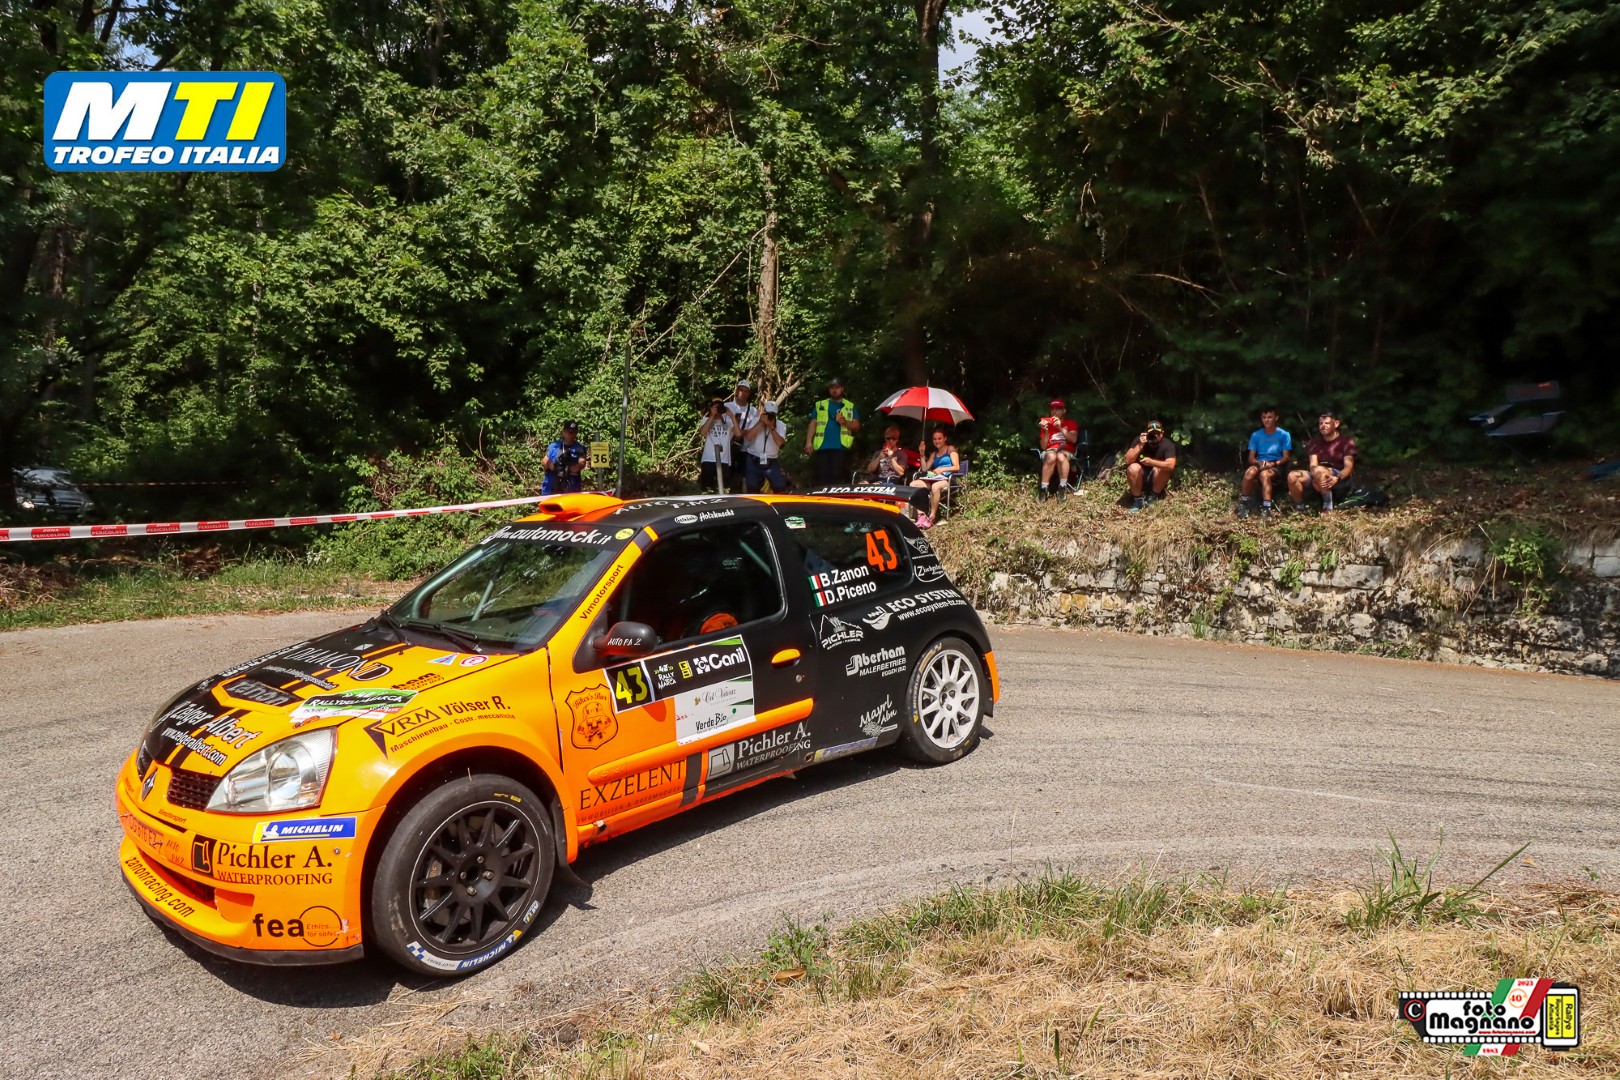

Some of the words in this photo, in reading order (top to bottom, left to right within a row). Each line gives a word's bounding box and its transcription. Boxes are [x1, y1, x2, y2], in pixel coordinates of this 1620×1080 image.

[593, 454, 608, 464] 36
[853, 486, 896, 495] SYSTEM
[865, 529, 898, 572] 43
[579, 564, 625, 620] Vimotorsport
[886, 596, 917, 613] ECO
[914, 588, 961, 604] SYSTEM
[821, 630, 864, 649] PICHLER
[708, 647, 746, 670] Canil
[859, 657, 907, 677] MALERBETRIEB
[614, 666, 649, 705] 43
[657, 671, 675, 680] RALLY
[657, 678, 677, 690] MARCA
[374, 708, 440, 736] VRM
[438, 700, 491, 716] Völser
[491, 695, 511, 710] R.
[859, 693, 893, 728] Mayrl
[200, 715, 263, 749] Albert
[390, 723, 449, 753] Maschinenbau
[737, 729, 791, 760] Pichler
[794, 721, 811, 741] A.
[736, 739, 811, 770] WATERPROOFING
[580, 759, 686, 810] EXZELENT
[281, 823, 344, 835] MICHELIN
[217, 842, 296, 869] Pichler
[305, 845, 333, 869] A.
[125, 857, 195, 918] zanonracing.com
[217, 869, 333, 886] WATERPROOFING
[252, 913, 305, 938] fea
[462, 943, 507, 968] MICHELIN
